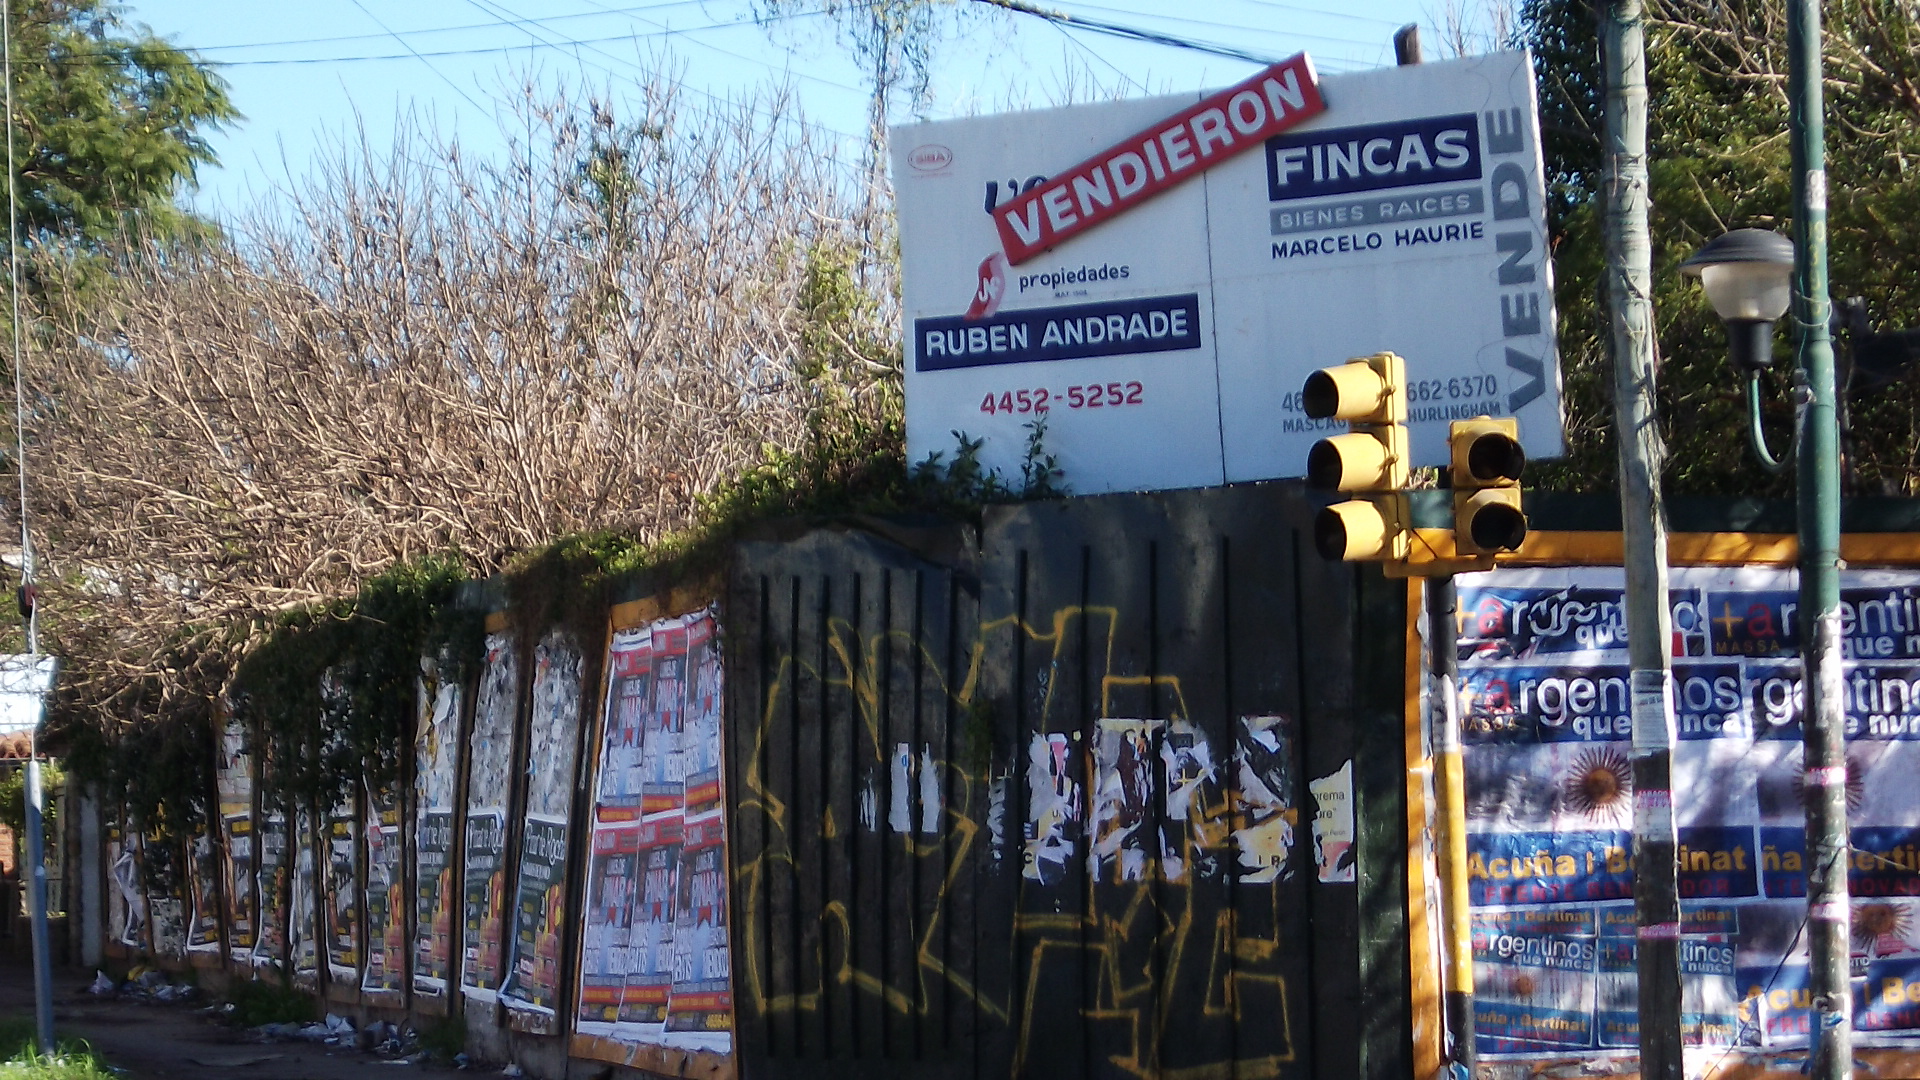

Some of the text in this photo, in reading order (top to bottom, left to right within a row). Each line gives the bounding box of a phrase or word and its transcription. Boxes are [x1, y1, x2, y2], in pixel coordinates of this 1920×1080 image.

[1005, 66, 1306, 248] VENDIERON
[1276, 128, 1470, 187] FINCAS
[1279, 193, 1470, 229] BIENES RAICES
[1271, 221, 1484, 260] MARCELO HAURIE
[1485, 106, 1546, 414] VENDE
[1019, 263, 1130, 293] propiedades
[925, 307, 1188, 357] RUBEN ANDRADE
[980, 380, 1144, 415] 4452-5252
[1405, 374, 1498, 402] 662-6370
[1407, 401, 1502, 423] HURLINGHAM
[1715, 639, 1781, 654] MASSA
[1467, 849, 1577, 881] Acuña
[1545, 955, 1593, 970] nunca
